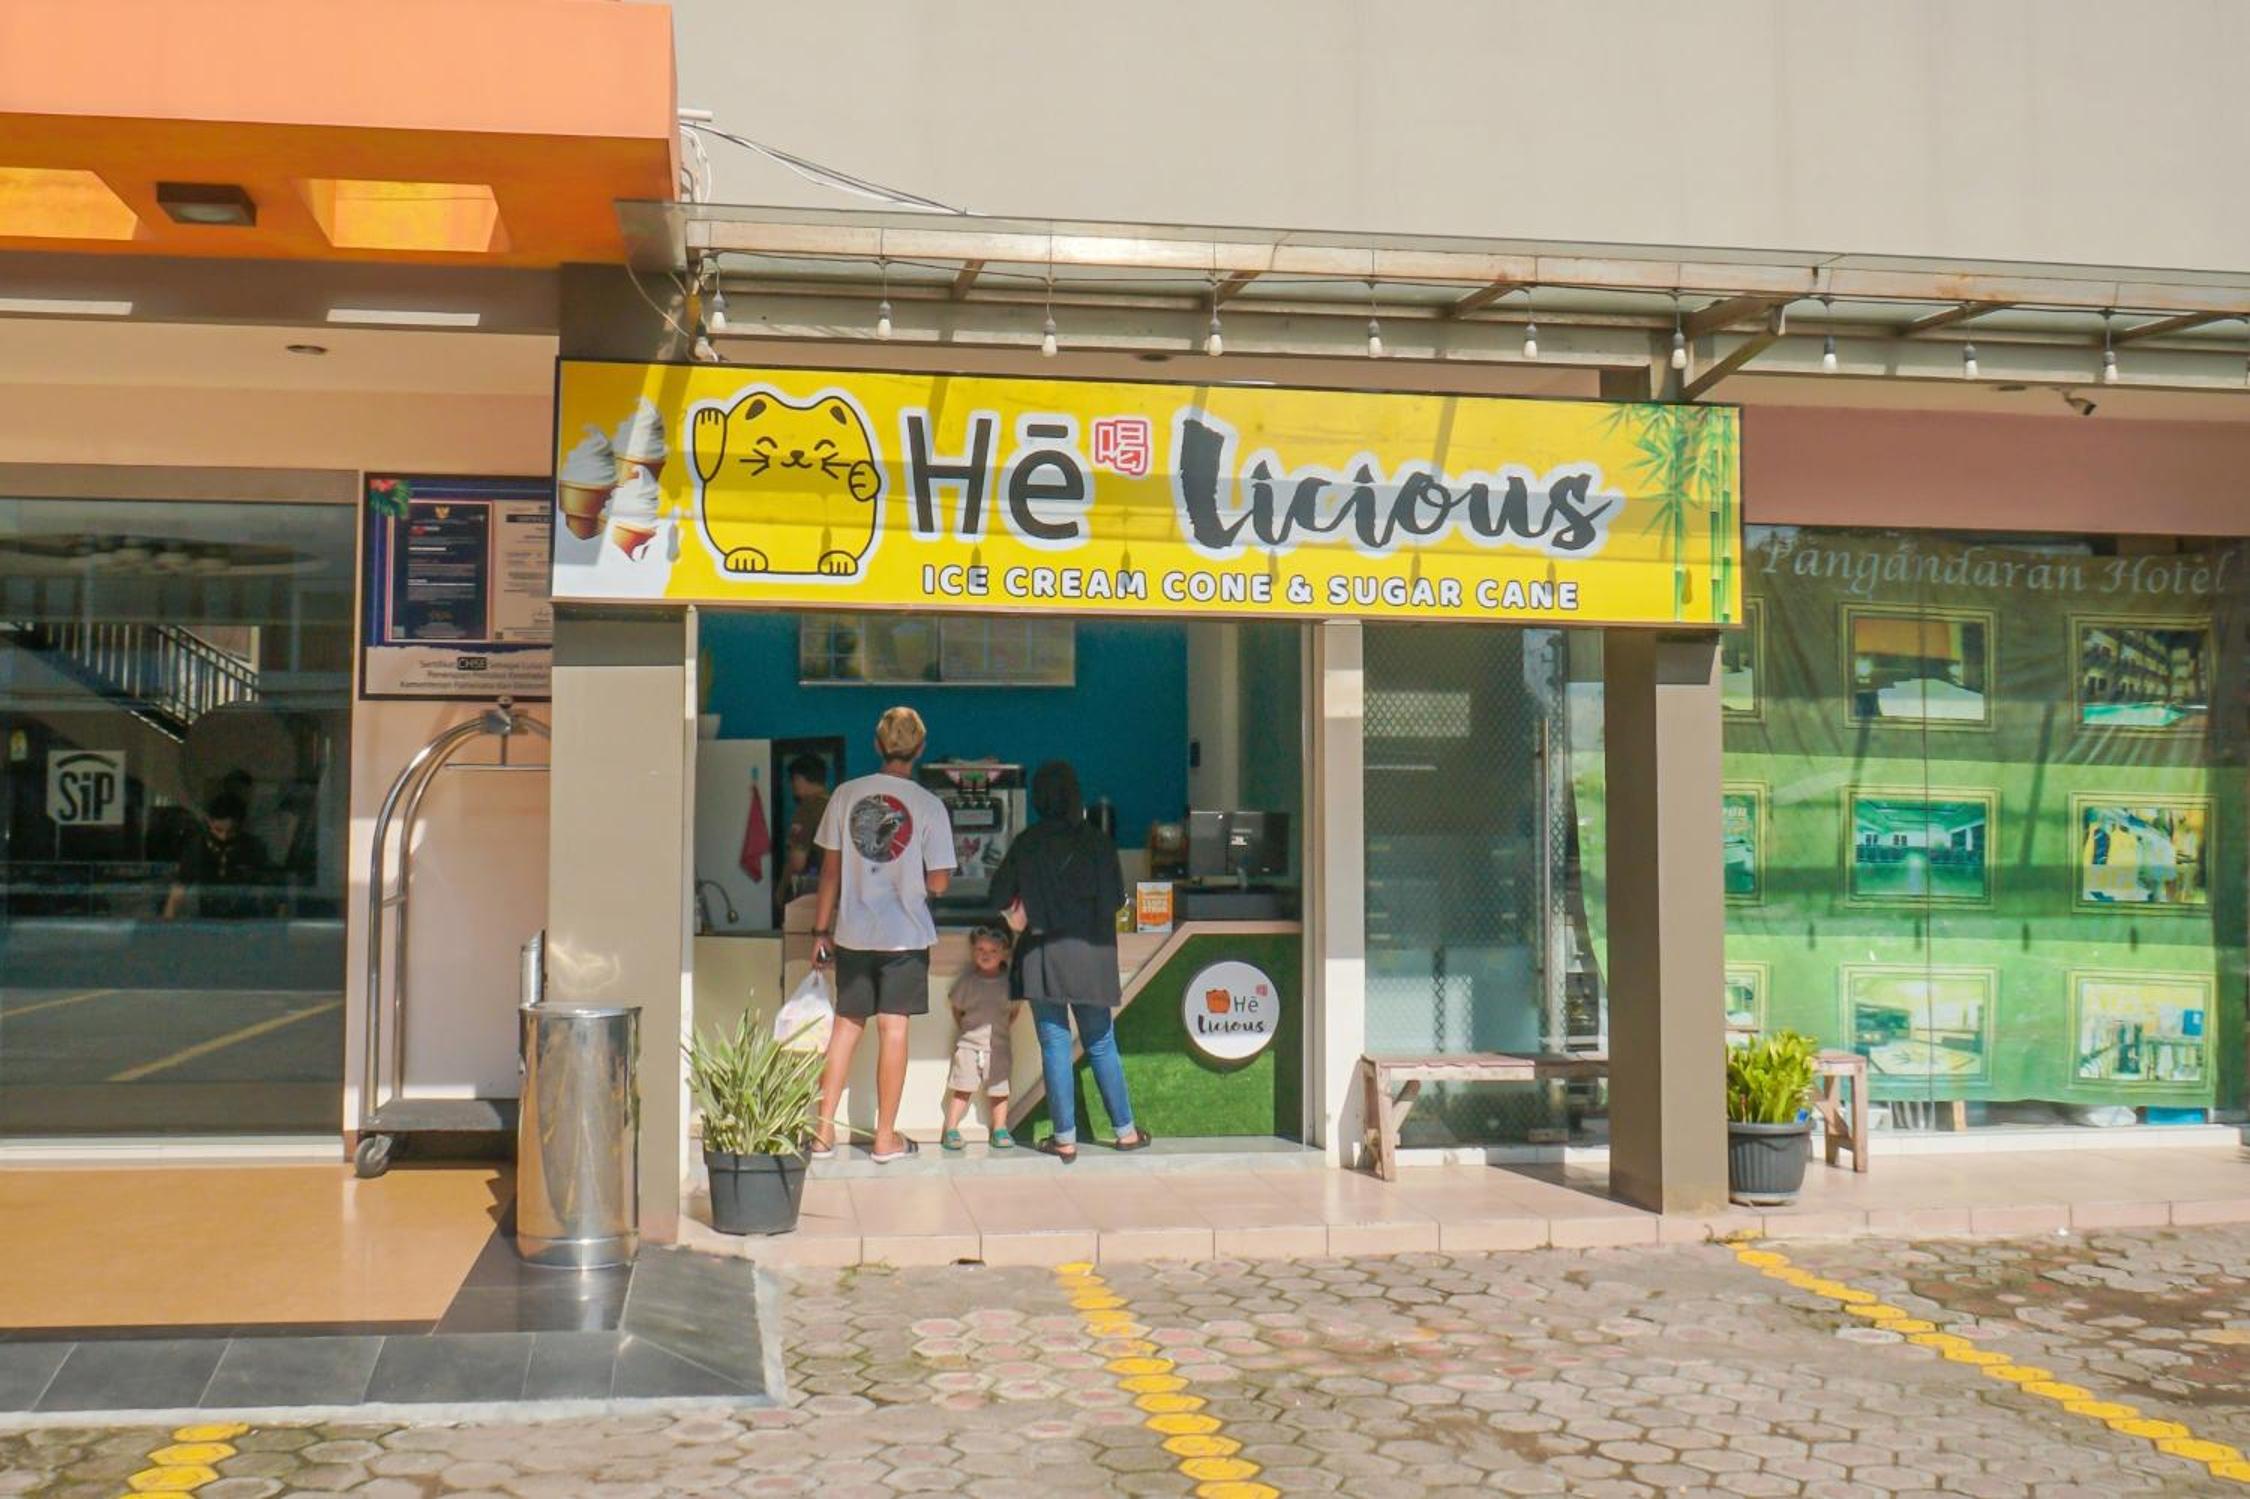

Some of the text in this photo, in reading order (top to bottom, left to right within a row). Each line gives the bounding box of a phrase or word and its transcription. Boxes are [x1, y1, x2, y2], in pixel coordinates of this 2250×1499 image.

[906, 415, 1086, 541] Hē
[922, 564, 1579, 609] ICE CREAM CONE & SUGAR CANE
[1760, 534, 2236, 600] Pangandaran Hotel
